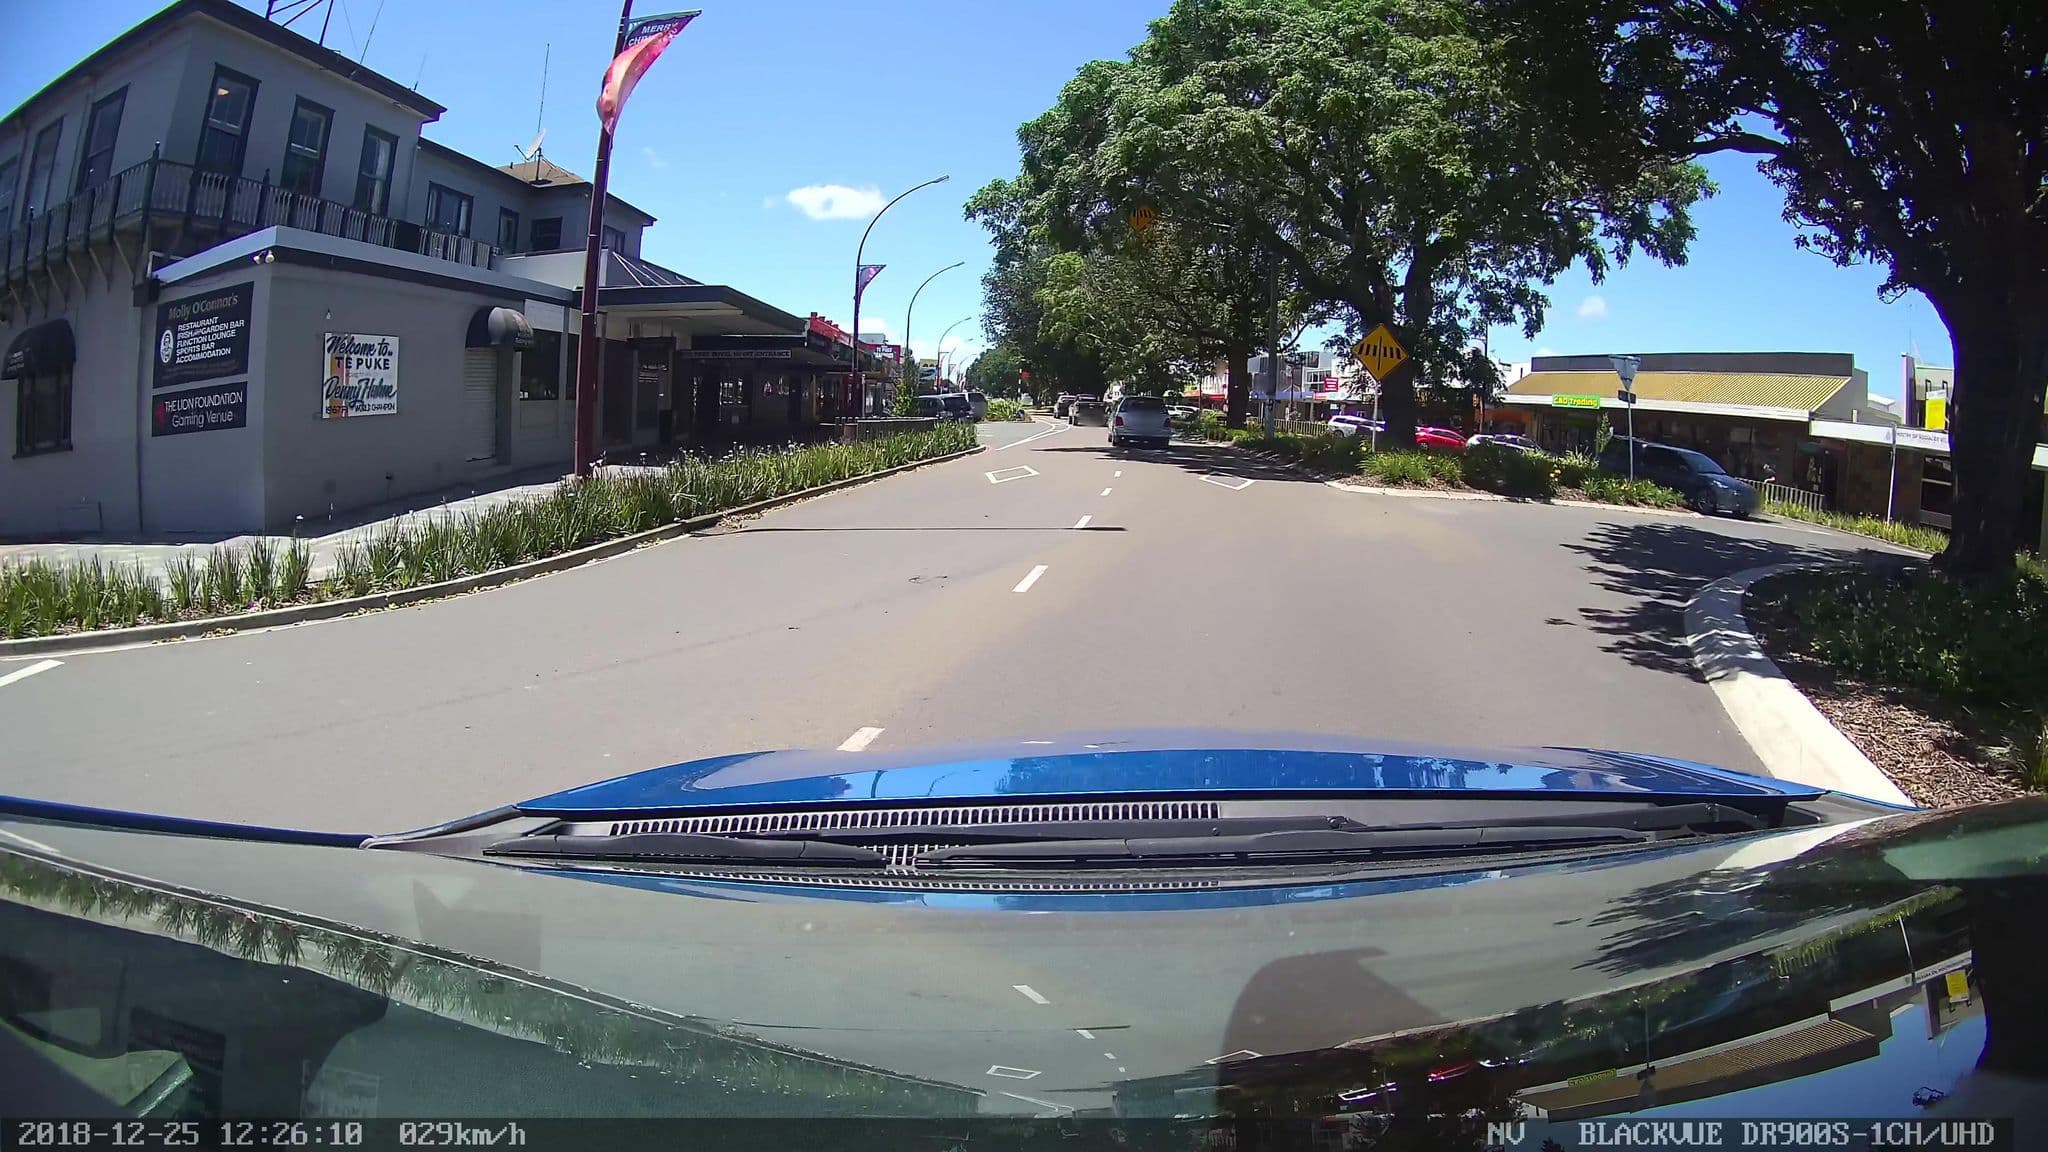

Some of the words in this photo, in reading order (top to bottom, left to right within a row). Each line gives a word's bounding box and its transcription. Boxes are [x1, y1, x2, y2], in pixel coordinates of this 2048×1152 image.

[641, 21, 679, 34] MERRY
[168, 303, 190, 321] Molly
[192, 292, 238, 314] O'Connor's
[177, 330, 193, 340] IRISH
[201, 322, 229, 335] GARDEN
[229, 319, 245, 329] BAR
[178, 316, 219, 332] RESTAURANT
[176, 335, 208, 349] FUNCTION
[207, 329, 237, 342] LOUNGE
[326, 335, 377, 356] Welcome
[175, 347, 231, 364] ACCOMMODATION
[176, 344, 201, 356] SPORTS
[201, 341, 215, 351] BAR
[335, 356, 353, 369] TE
[356, 357, 390, 370] PUKE
[164, 400, 177, 412] THE
[177, 397, 195, 411] LION
[194, 391, 243, 409] FOUNDATION
[172, 412, 205, 428] Gaming
[206, 410, 234, 424] Venue
